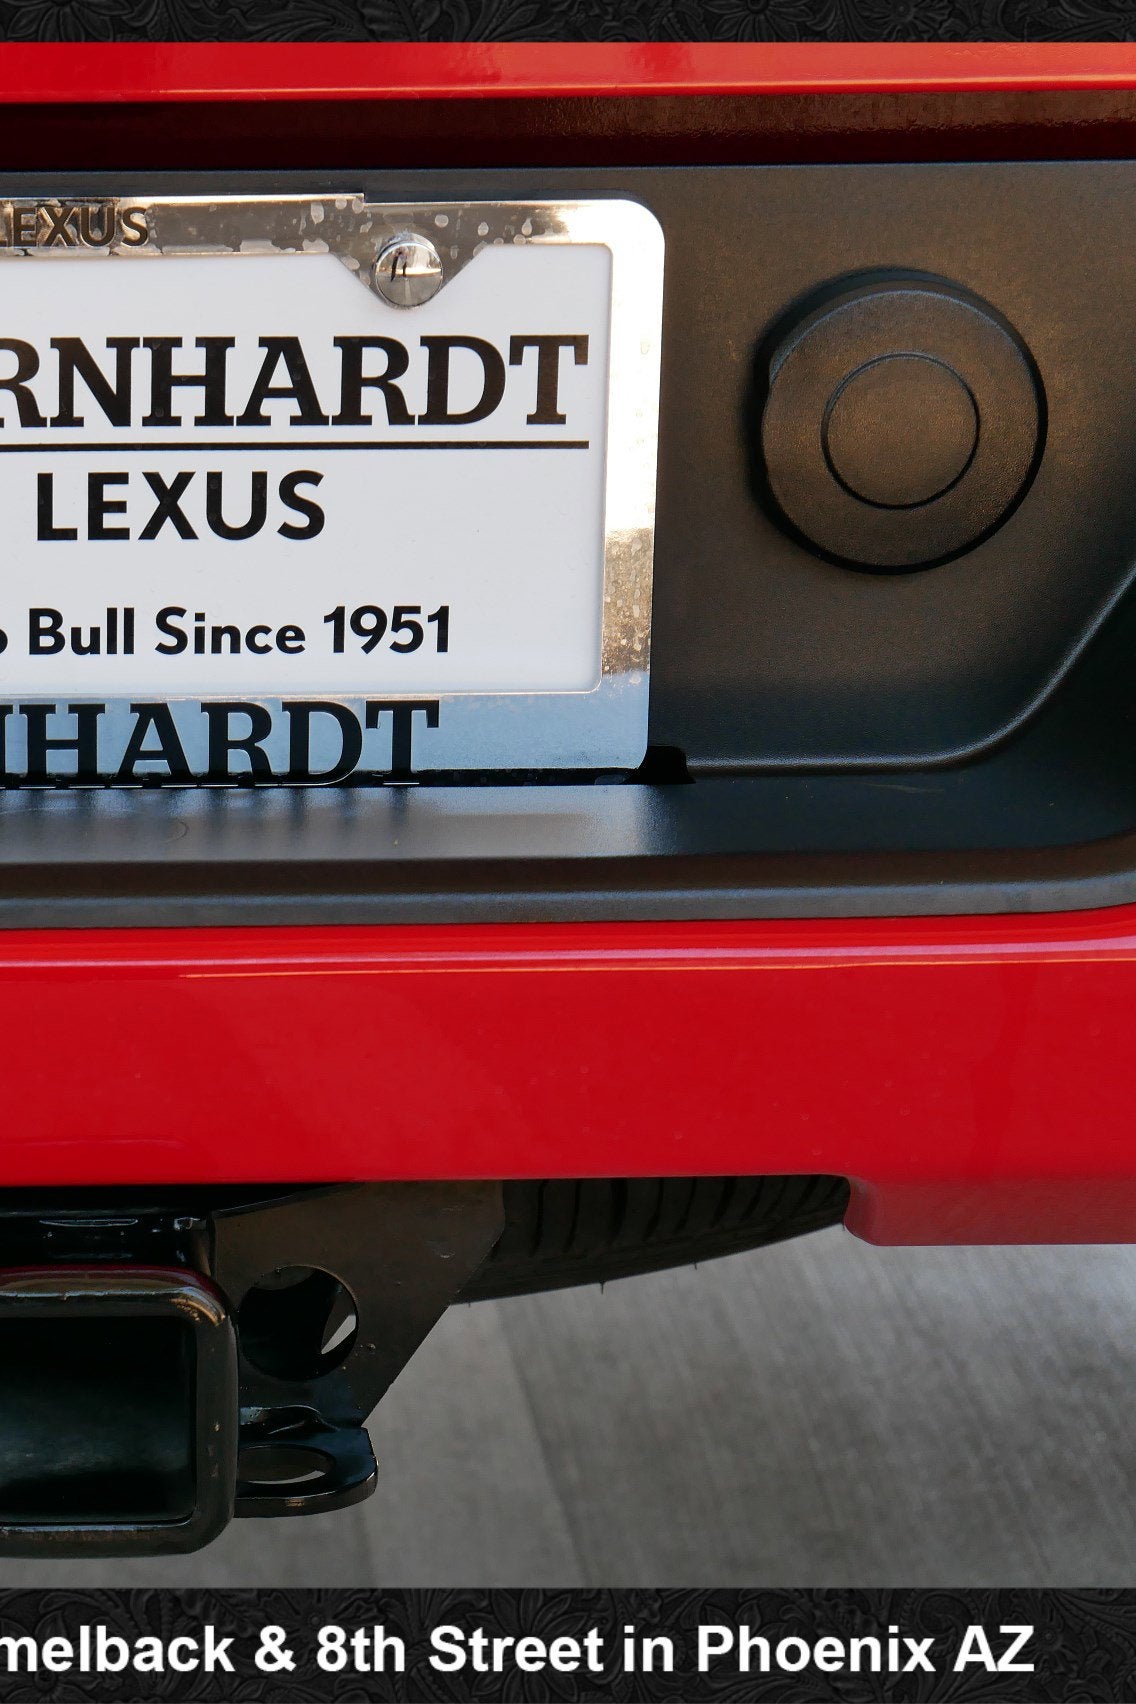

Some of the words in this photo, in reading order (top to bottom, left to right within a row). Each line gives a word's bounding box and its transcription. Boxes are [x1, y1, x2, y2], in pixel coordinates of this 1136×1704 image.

[37, 469, 325, 542] LEXUS
[28, 607, 135, 656] Bull
[154, 606, 306, 656] Since
[323, 604, 450, 655] 1951
